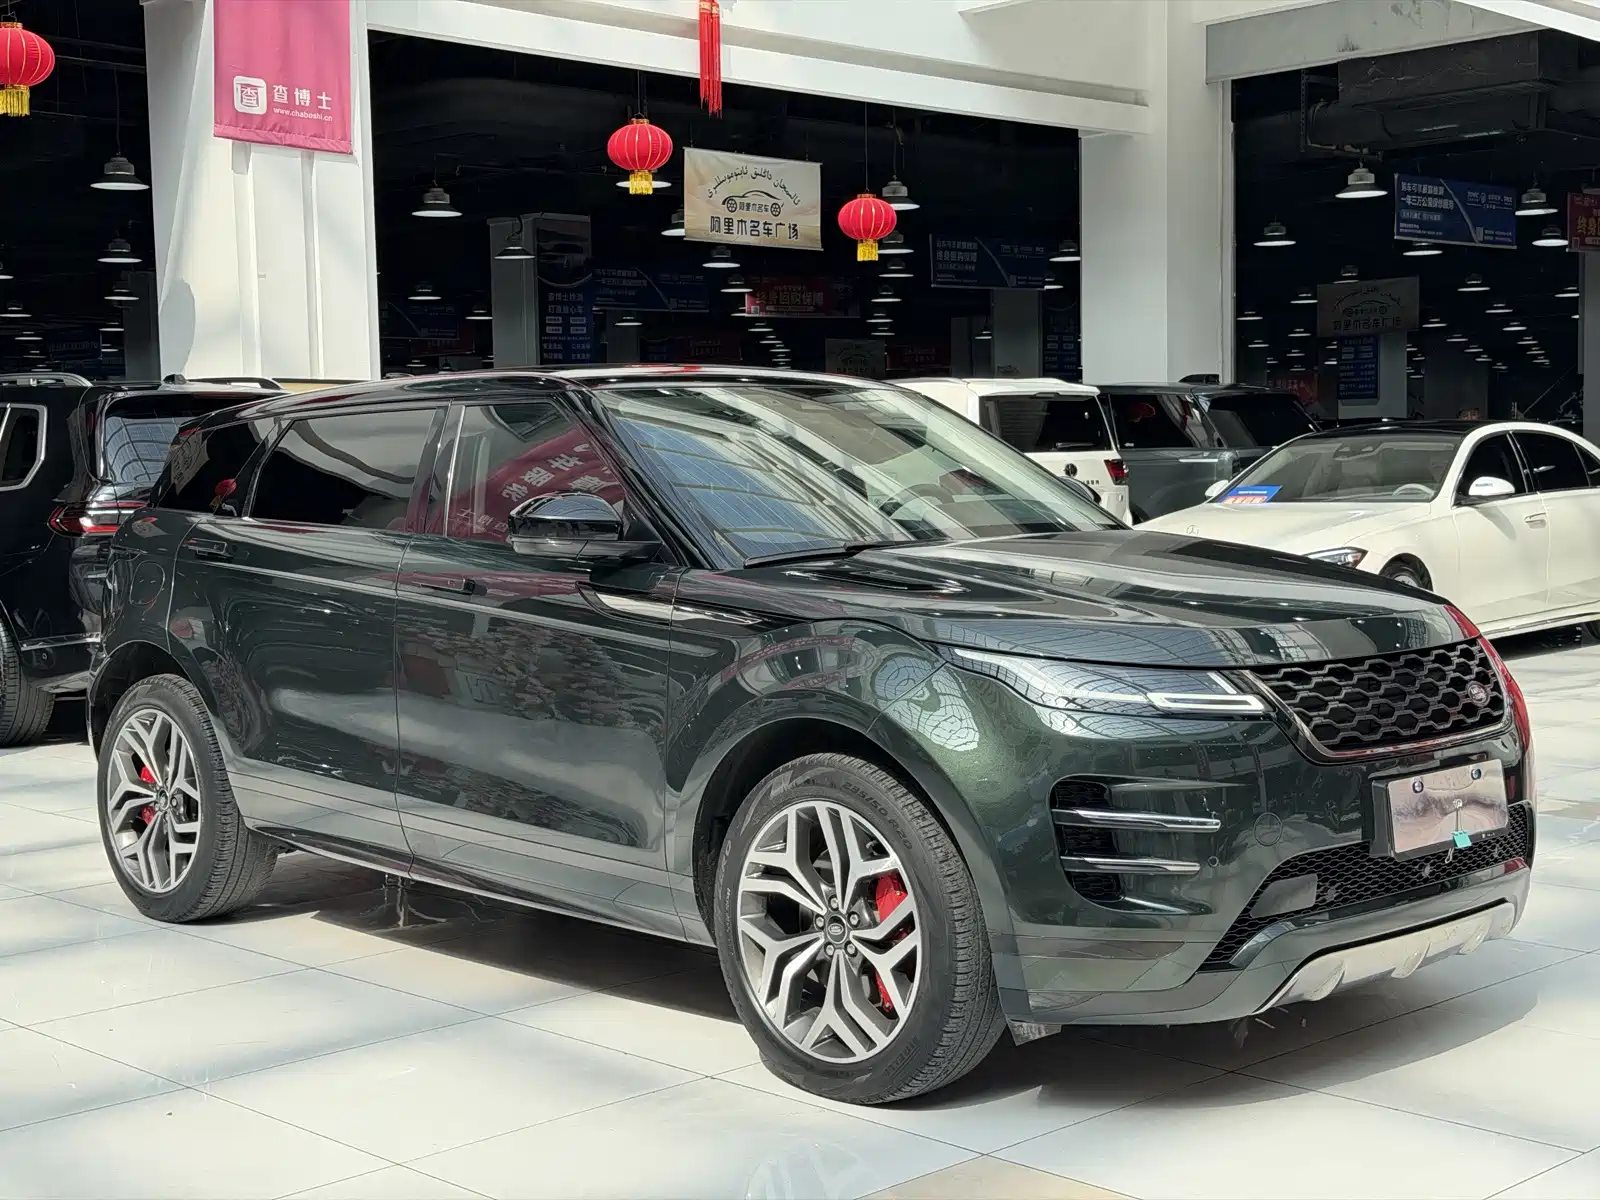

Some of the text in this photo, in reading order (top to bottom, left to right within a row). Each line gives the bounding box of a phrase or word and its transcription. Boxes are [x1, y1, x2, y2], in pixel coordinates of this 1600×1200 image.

[272, 84, 332, 110] 查博士
[273, 107, 333, 122] www.chaboshi.cn
[738, 201, 770, 213] 阿里木名车
[710, 215, 799, 240] 阿里木名车广场
